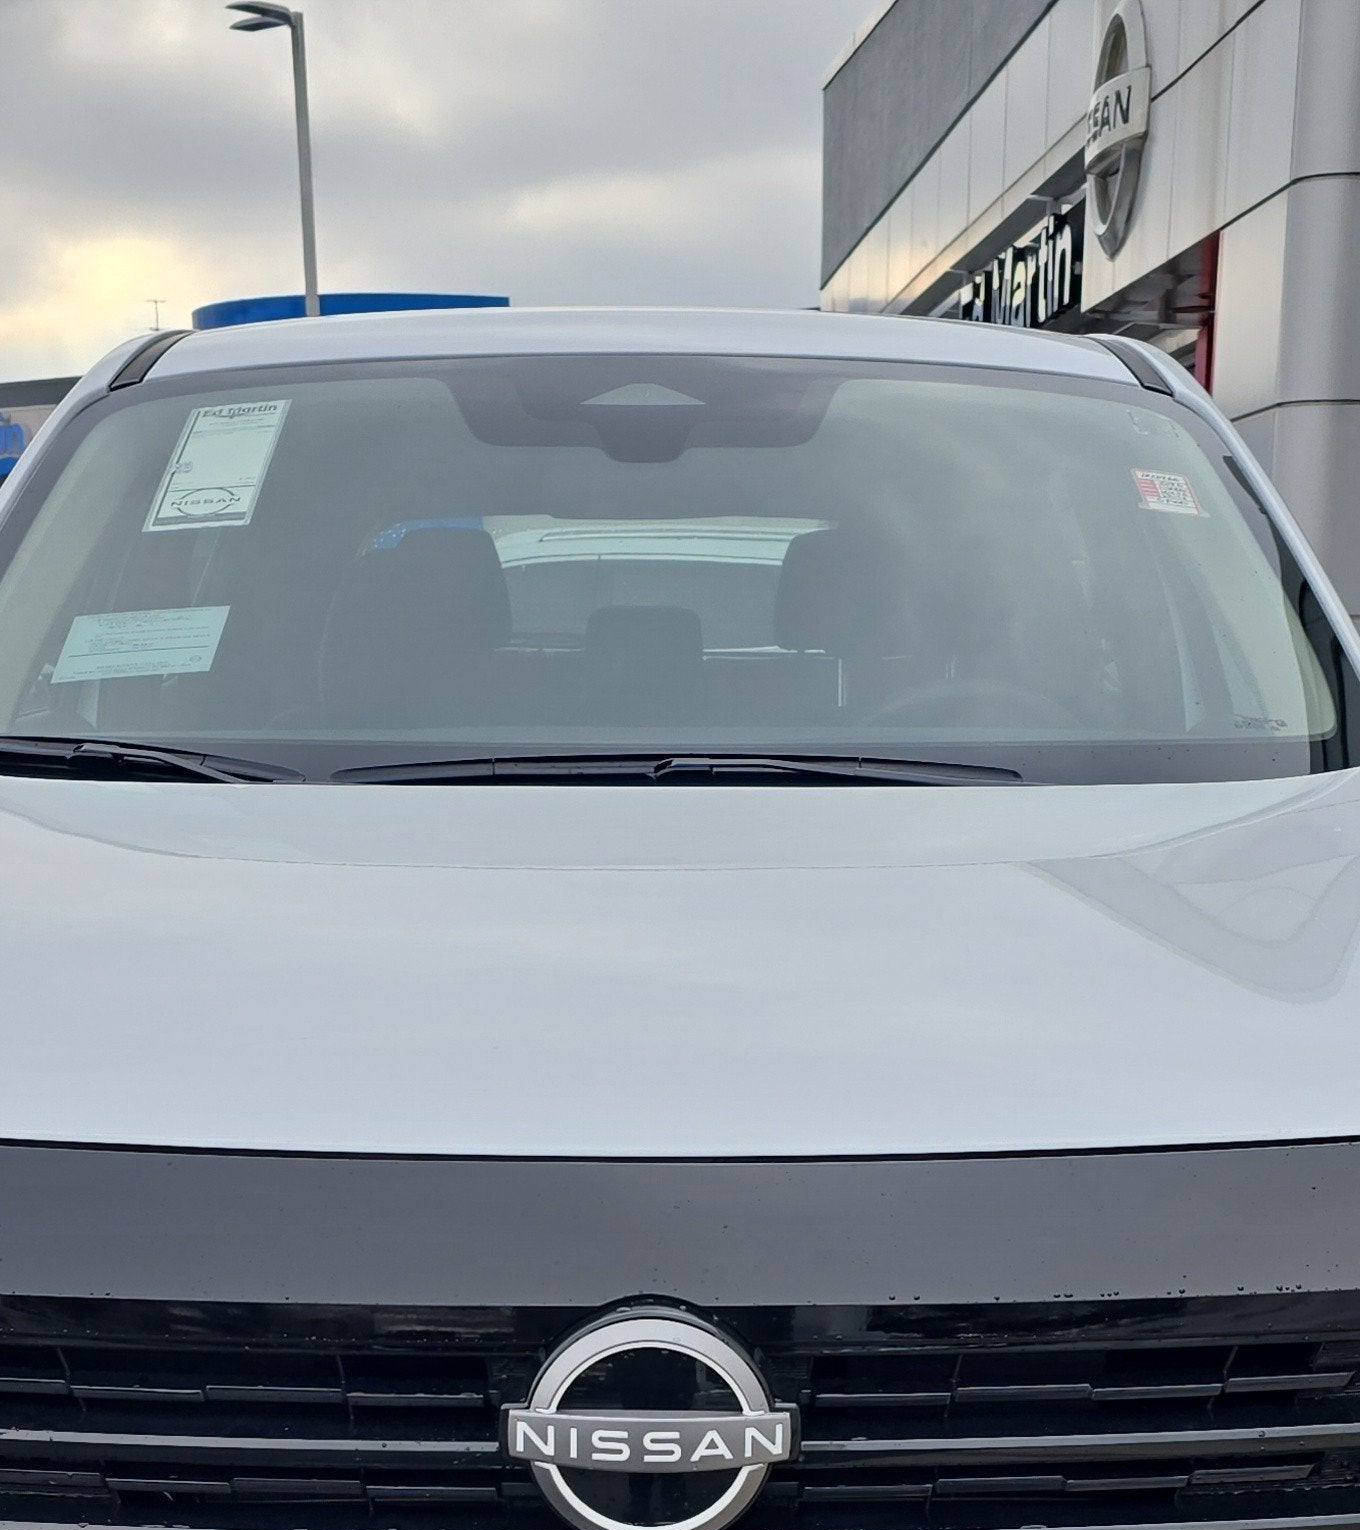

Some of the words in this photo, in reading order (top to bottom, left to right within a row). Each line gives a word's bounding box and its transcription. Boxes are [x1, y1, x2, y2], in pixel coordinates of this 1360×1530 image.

[228, 403, 278, 418] Martin
[170, 497, 241, 506] NISSAN
[515, 1420, 784, 1463] NISSAN
